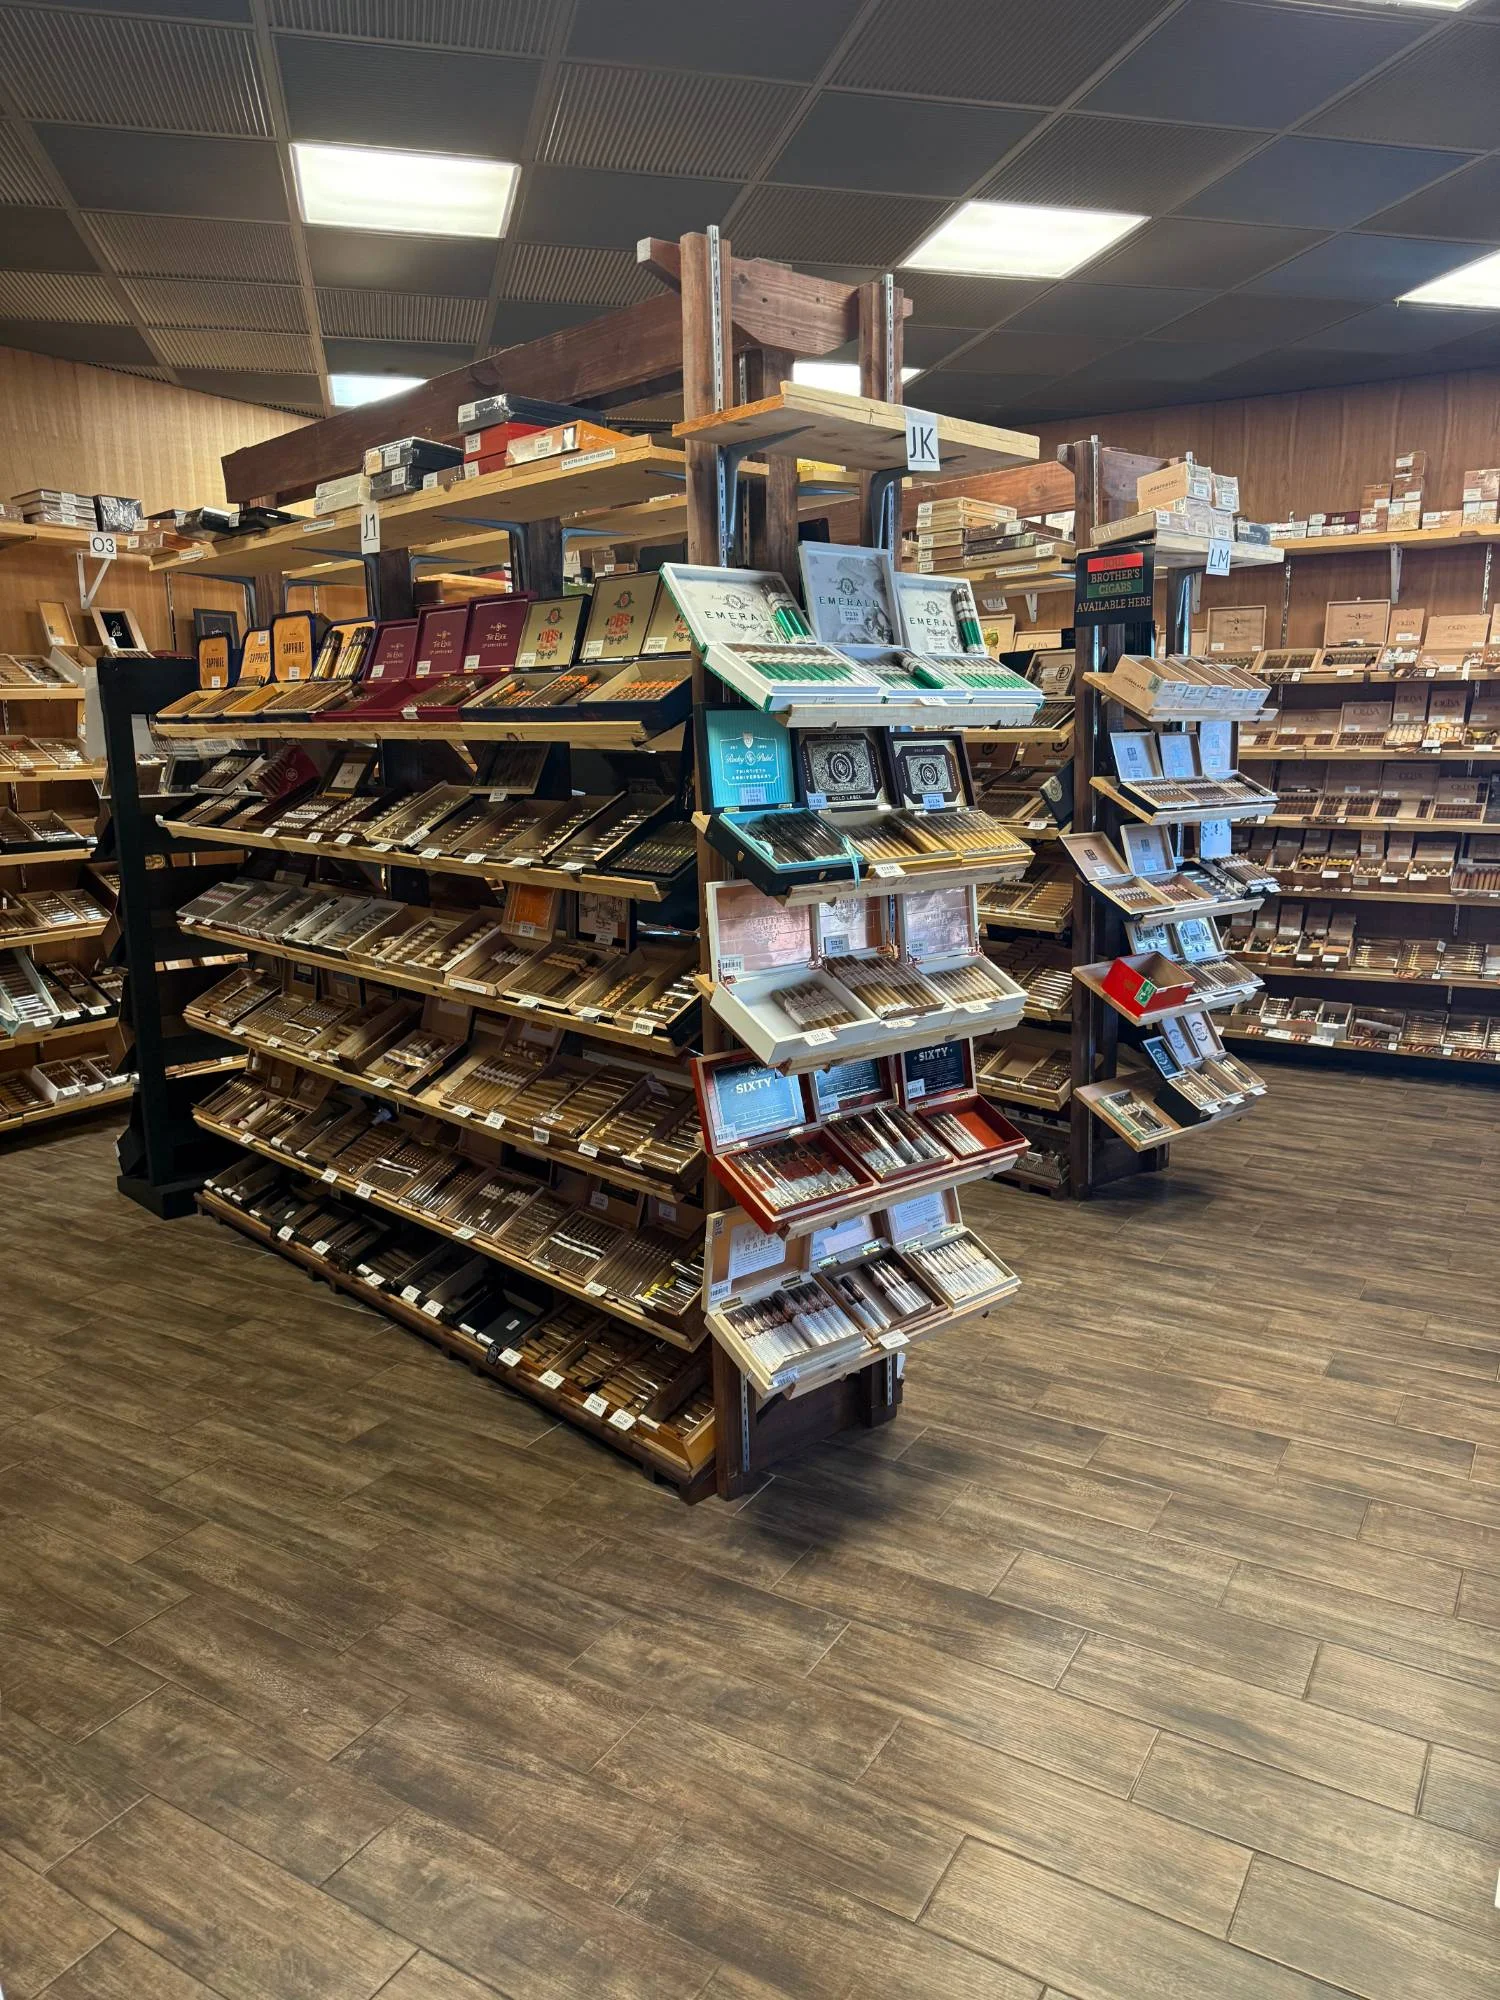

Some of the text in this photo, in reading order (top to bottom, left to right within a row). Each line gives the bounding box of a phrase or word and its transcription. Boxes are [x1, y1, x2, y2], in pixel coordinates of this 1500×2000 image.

[909, 426, 936, 460] JK
[363, 512, 378, 540] J1
[1209, 548, 1230, 569] LM
[1091, 568, 1140, 584] BROTHER'S
[1098, 581, 1132, 594] CIGARS
[819, 596, 880, 608] EMERALD
[1076, 596, 1151, 613] AVAILABLE HERE
[705, 610, 772, 622] EMERAL
[909, 617, 956, 628] EMERAL
[282, 641, 305, 655] SAPPHIRE
[918, 1046, 949, 1062] SIXTY
[735, 1077, 772, 1095] SIXTY
